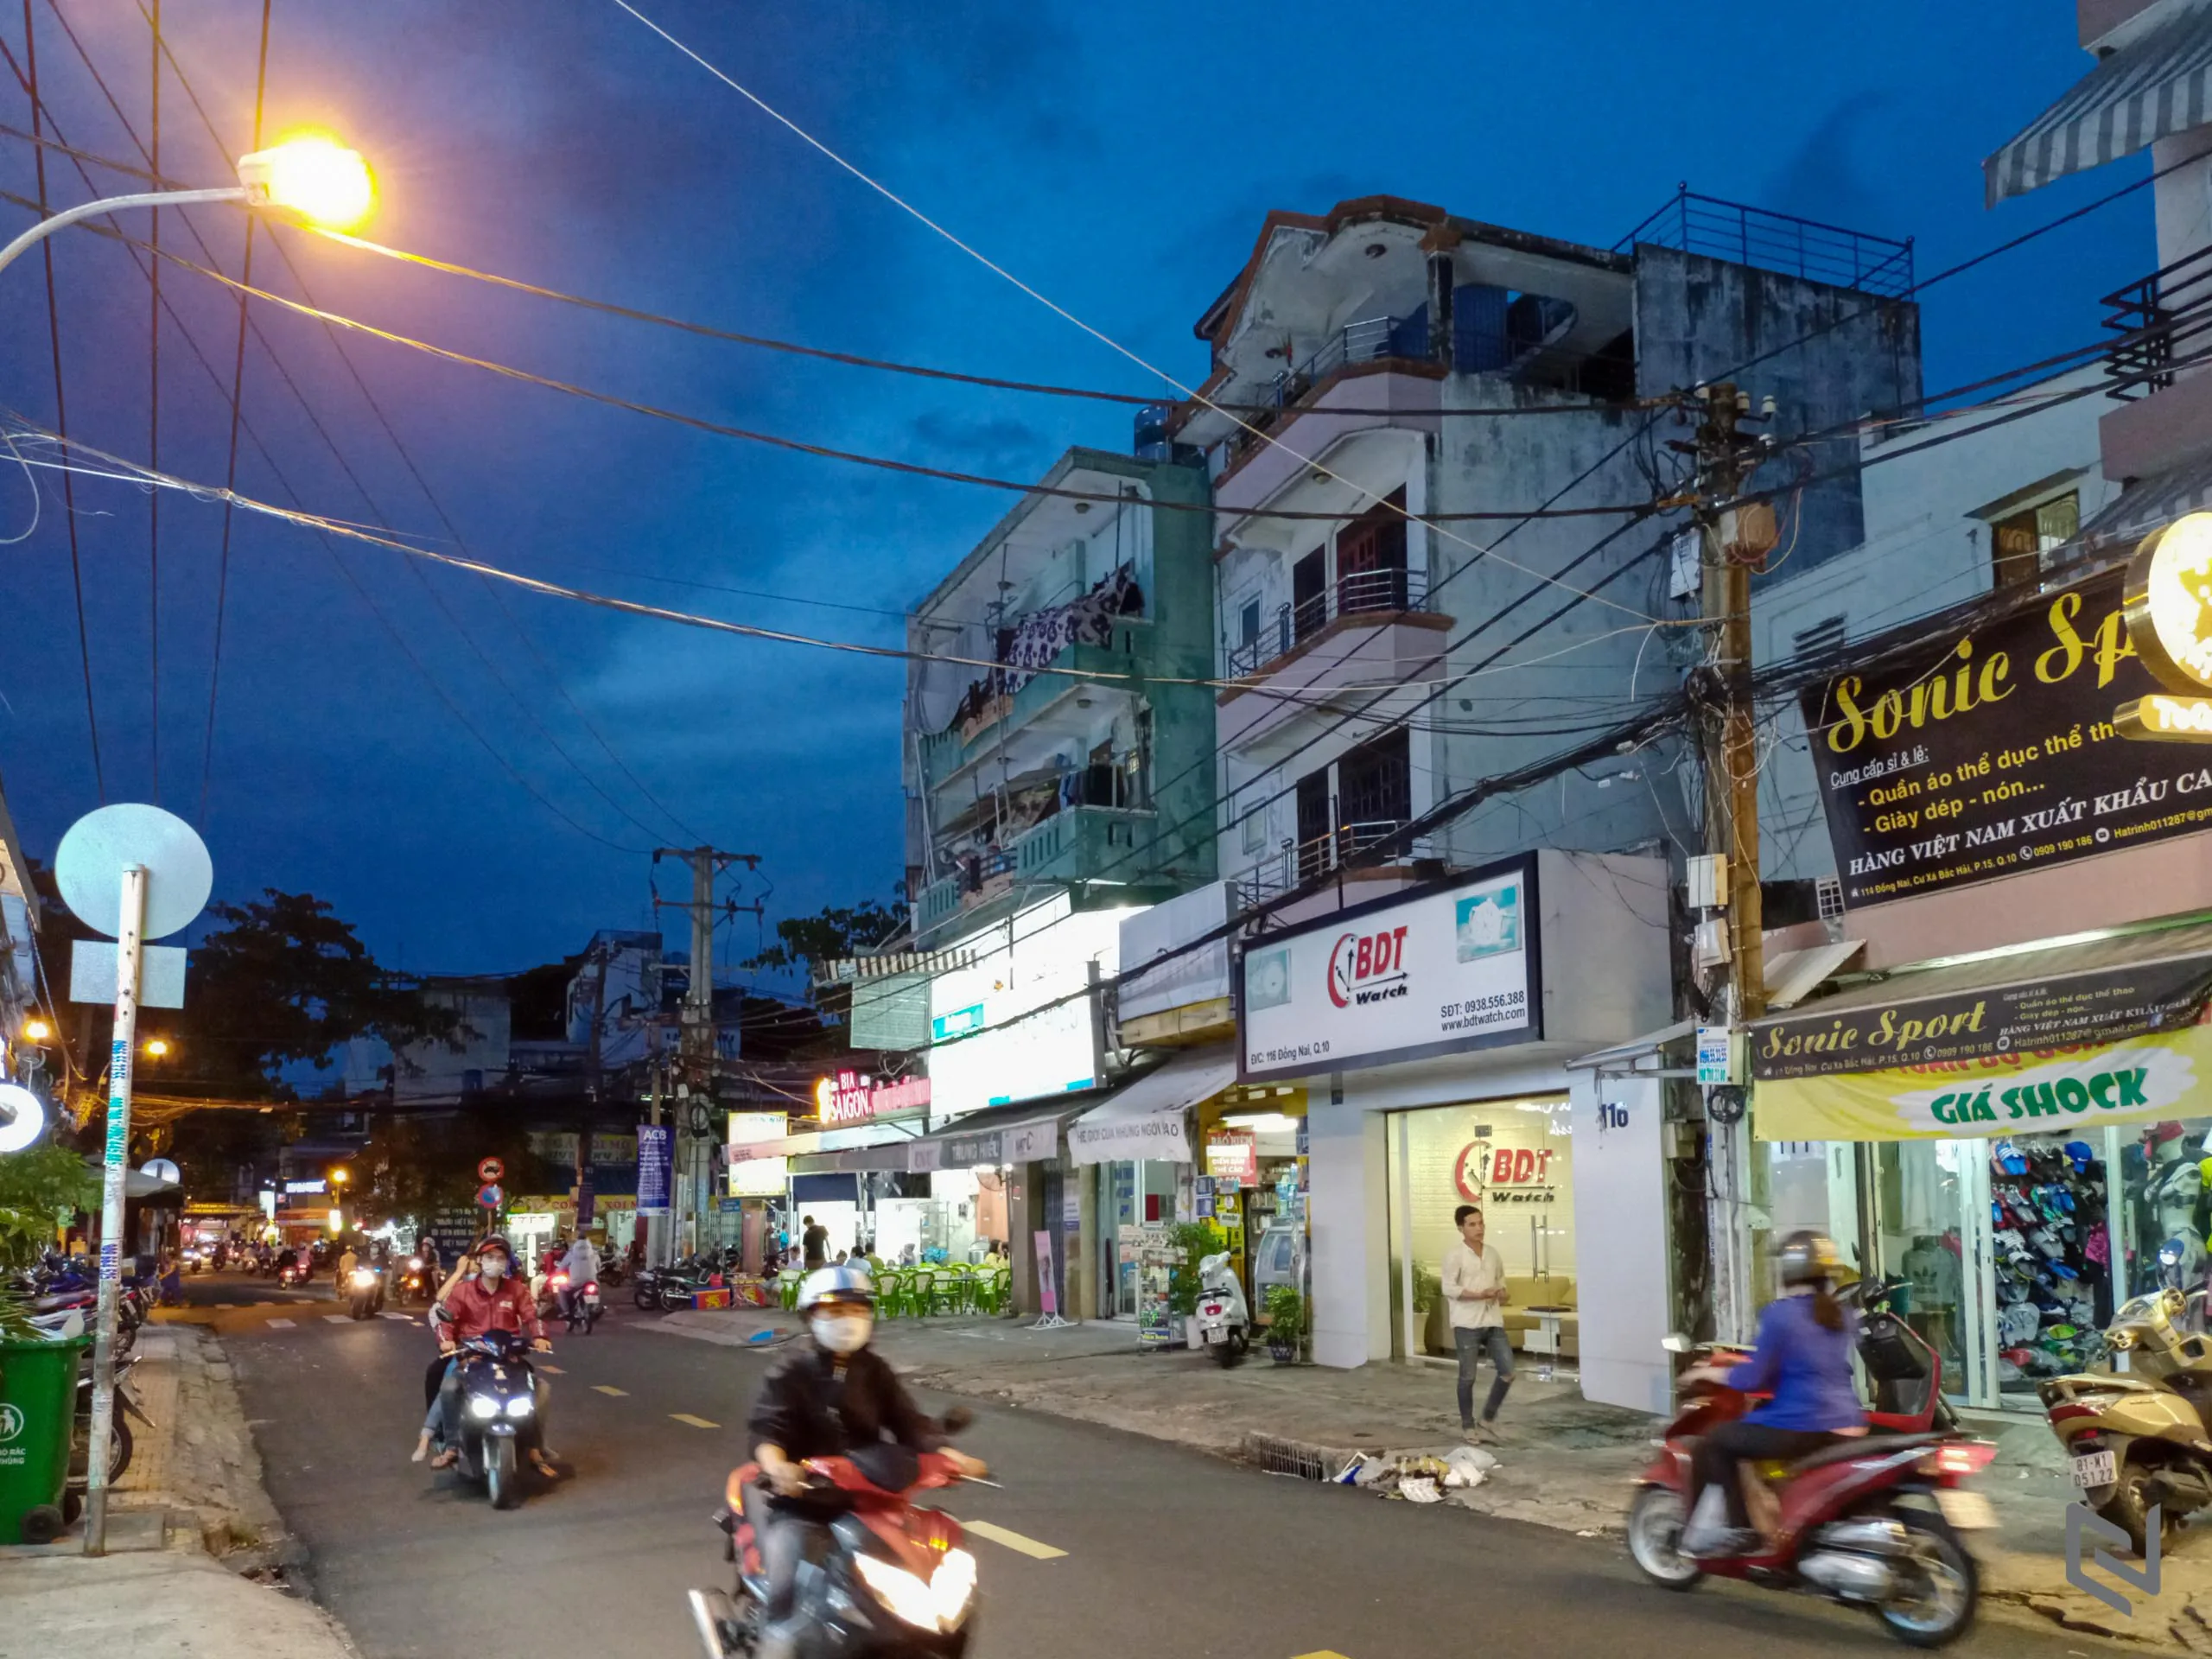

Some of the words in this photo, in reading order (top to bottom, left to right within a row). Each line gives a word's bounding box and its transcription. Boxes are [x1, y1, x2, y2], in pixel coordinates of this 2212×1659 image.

[1827, 638, 2016, 753] Sonic
[1831, 768, 1859, 787] Cung
[1863, 758, 1884, 777] cấp
[1870, 779, 1922, 805] Quần
[1927, 772, 1953, 791] áo
[1956, 752, 1991, 781] thể
[1997, 746, 2040, 767] dục
[2044, 723, 2083, 755] thể
[1849, 848, 1906, 876] HÀNG
[1909, 833, 1961, 859] VIỆT
[1966, 818, 2016, 849] NAM
[2021, 797, 2088, 834] XUẤT
[2093, 776, 2170, 816] KHẨU
[1875, 810, 1919, 833] Giày
[1925, 798, 1964, 818] dép
[1354, 925, 1409, 981] BDT
[1355, 983, 1409, 1006] Watch
[1465, 990, 1525, 1014] 0938.556.388
[1441, 1007, 1526, 1032] www.bdtwatch.com
[1762, 1020, 1858, 1058] Sonic
[1867, 1000, 1986, 1051] Sport
[840, 1071, 855, 1090] BIA
[1930, 1084, 1998, 1125] GIÁ
[2000, 1067, 2149, 1119] SHOCK
[643, 1129, 667, 1141] ACB
[1491, 1148, 1553, 1184] BDT
[1492, 1191, 1555, 1203] Watch
